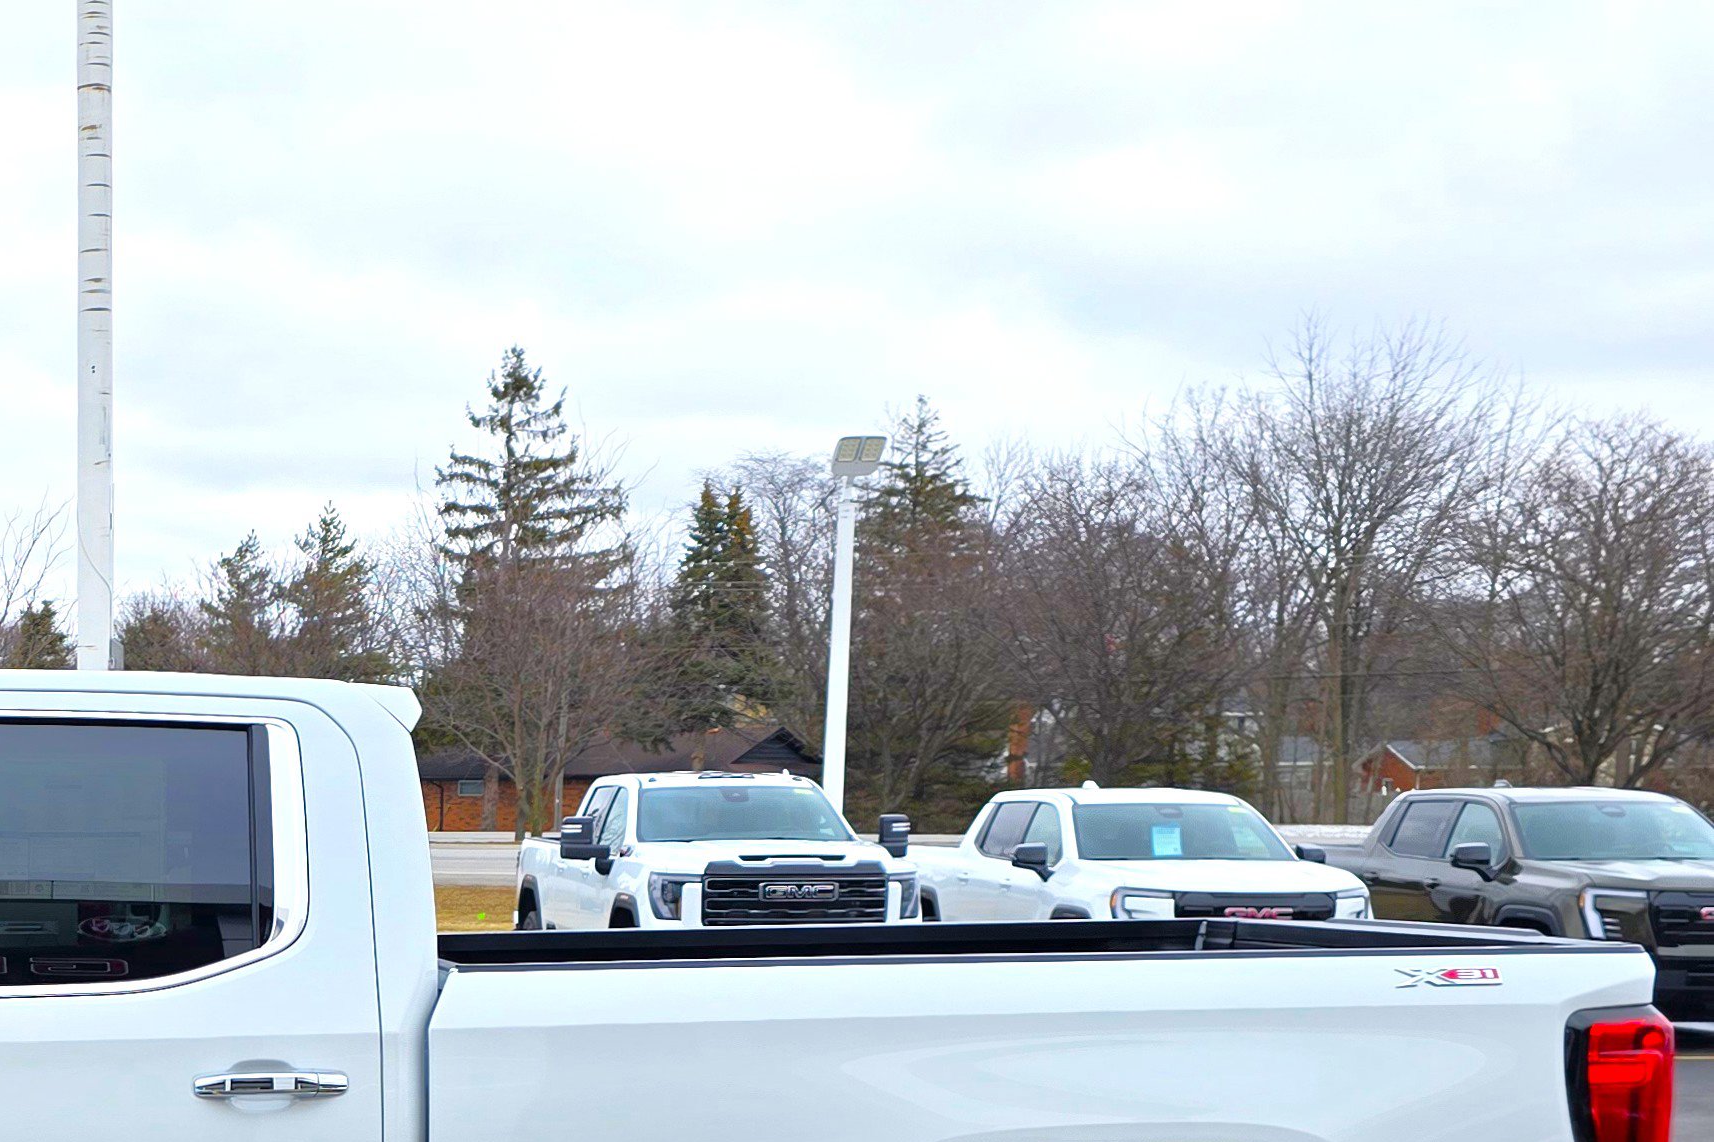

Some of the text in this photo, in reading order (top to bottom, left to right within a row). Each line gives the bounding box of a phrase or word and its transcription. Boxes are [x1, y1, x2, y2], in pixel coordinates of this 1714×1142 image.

[765, 885, 834, 899] GMC
[1223, 907, 1294, 920] GMC
[1392, 968, 1503, 988] X31
